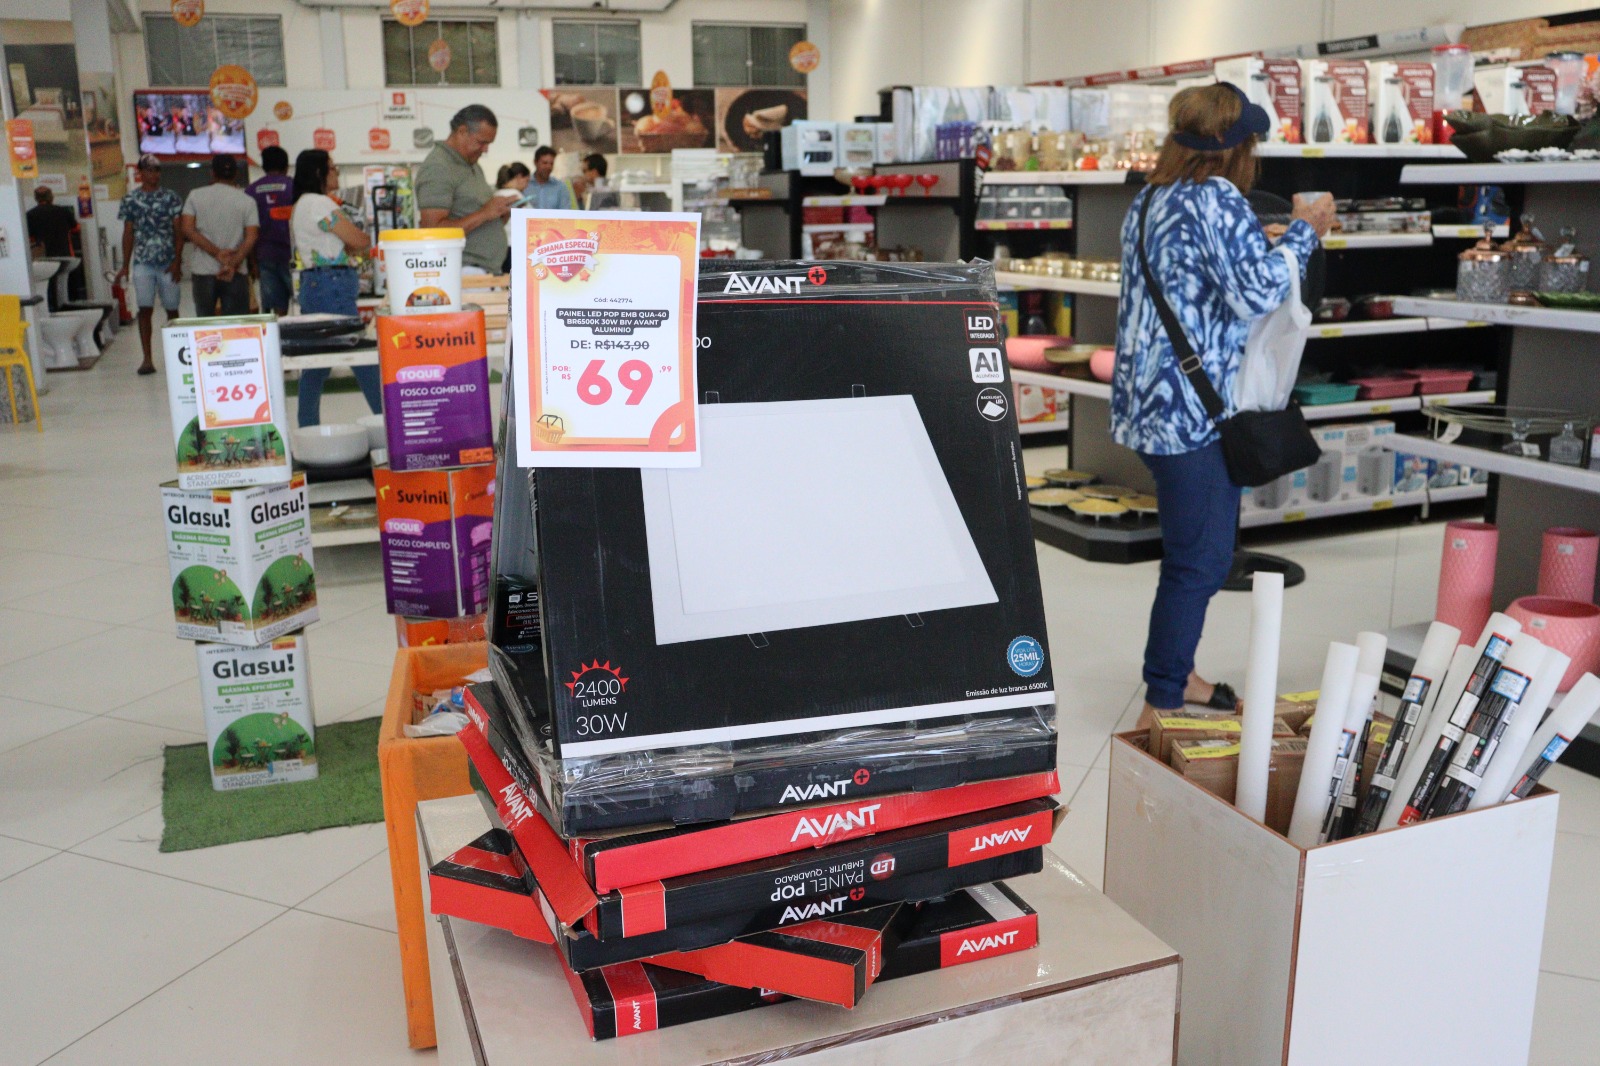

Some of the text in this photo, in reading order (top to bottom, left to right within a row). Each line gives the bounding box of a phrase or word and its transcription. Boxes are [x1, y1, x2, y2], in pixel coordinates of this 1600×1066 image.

[537, 241, 596, 255] SEMANA ESPECIAL
[405, 257, 447, 269] Glasu!
[559, 255, 586, 263] CLIENTE
[723, 272, 806, 294] AVANT
[967, 316, 994, 331] LED
[415, 331, 476, 349] Suvinil
[570, 339, 650, 352] DE: R$143,90
[401, 368, 441, 381] TOQUE
[561, 372, 571, 381] R$
[576, 359, 653, 406] 69
[216, 383, 258, 403] 269
[400, 383, 477, 397] FOSCO COMPLETO
[397, 489, 448, 505] Suvinil
[168, 504, 231, 528] Glasu!
[251, 491, 304, 524] Glasu!
[388, 521, 420, 532] TOQUE
[388, 538, 451, 550] FOSCO COMPLETO
[1013, 651, 1040, 663] 25MIL
[213, 653, 295, 679] Glasu!
[574, 678, 621, 698] 2400
[965, 688, 990, 698] Emissão
[999, 686, 1008, 694] luz
[1008, 684, 1028, 693] branca
[1028, 681, 1049, 691] 6500K
[582, 697, 617, 707] LUMENS
[576, 712, 628, 736] 30W
[779, 779, 852, 804] AVANT
[499, 781, 533, 825] AVANT
[790, 803, 881, 843] AVANT
[970, 825, 1032, 853] AVANT
[829, 859, 865, 874] EMBUTIR
[870, 858, 896, 875] LED
[774, 868, 823, 885] QUADRADO
[770, 869, 864, 902] PAINEL POP
[778, 896, 848, 925] AVANT
[956, 930, 1019, 957] AVANT
[632, 1000, 641, 1030] AVANT
